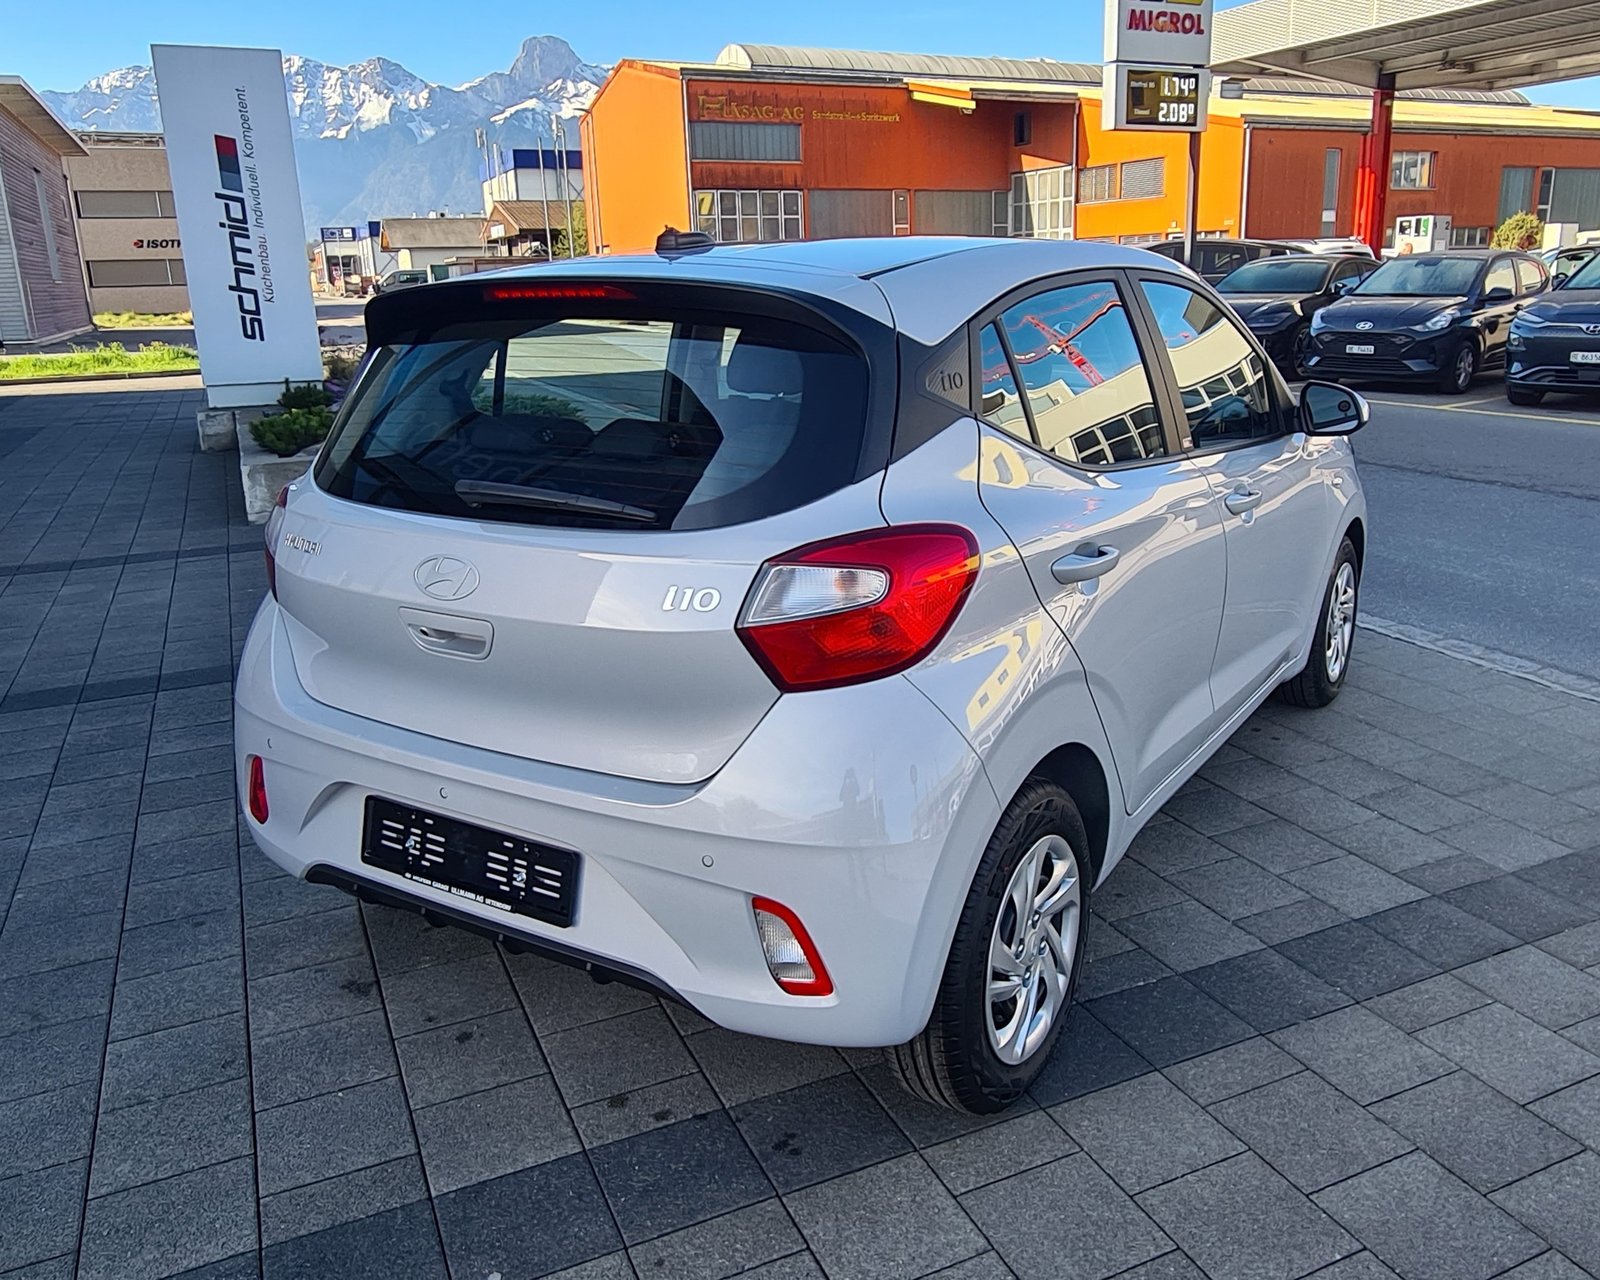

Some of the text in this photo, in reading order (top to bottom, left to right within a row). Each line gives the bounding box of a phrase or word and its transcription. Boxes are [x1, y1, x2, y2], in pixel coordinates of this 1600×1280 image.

[1127, 9, 1205, 35] MIGROL
[781, 106, 804, 119] AG
[235, 85, 275, 304] Küchenbau. Individuell. Kompetent.
[1444, 220, 1450, 230] 2
[214, 192, 265, 342] schmid
[940, 370, 963, 392] i10
[284, 532, 322, 556] HYUNDAI
